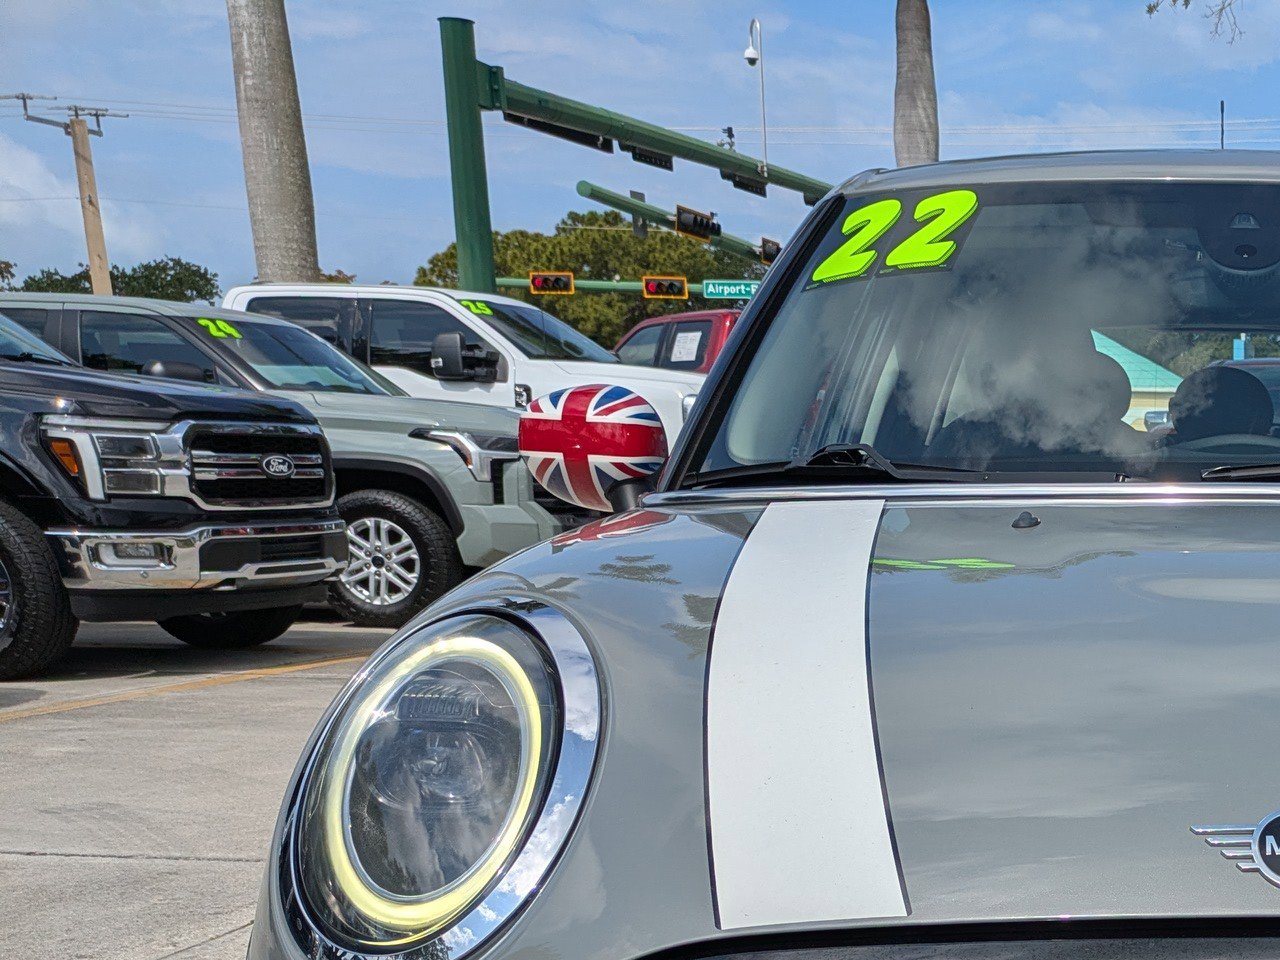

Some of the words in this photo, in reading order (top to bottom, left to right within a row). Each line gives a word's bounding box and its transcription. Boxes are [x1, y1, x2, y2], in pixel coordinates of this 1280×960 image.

[812, 190, 978, 283] 22
[461, 300, 494, 316] 25
[197, 318, 243, 339] 24
